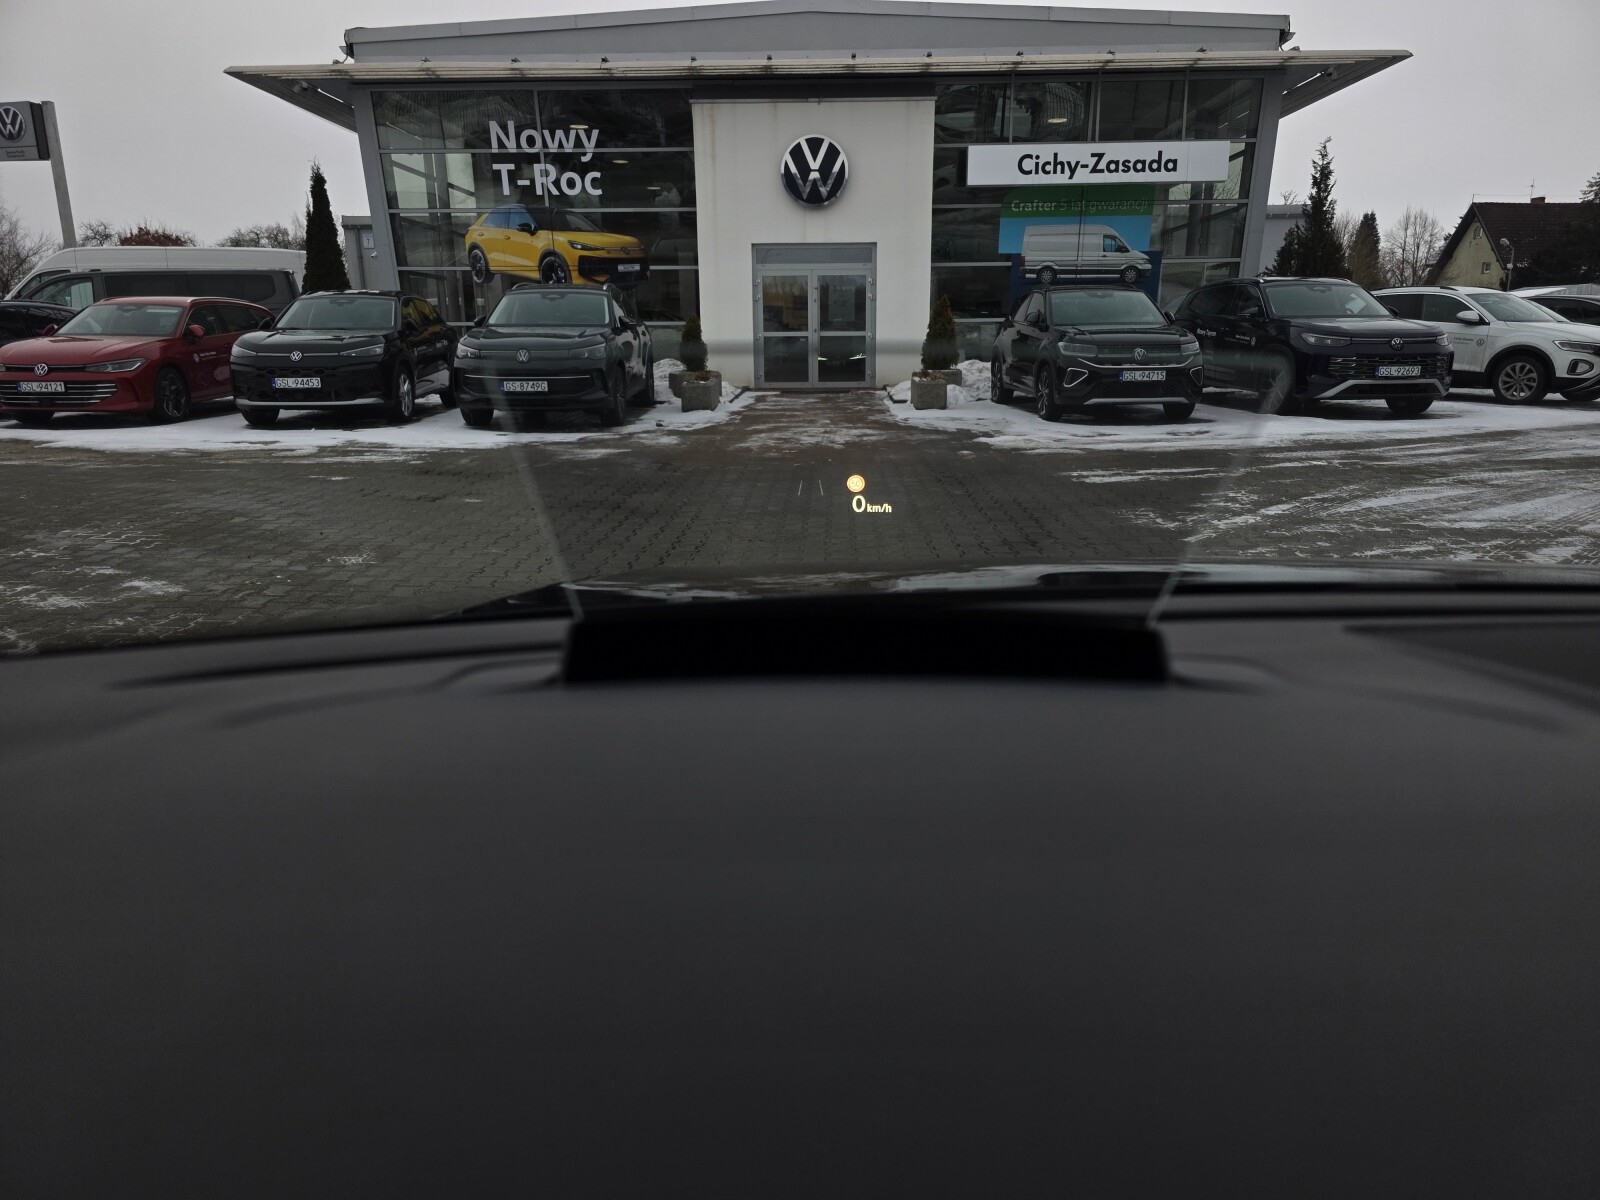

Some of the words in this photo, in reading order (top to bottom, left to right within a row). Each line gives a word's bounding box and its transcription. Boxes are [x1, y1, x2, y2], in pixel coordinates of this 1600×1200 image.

[488, 120, 599, 162] Nowy
[782, 134, 848, 206] VW
[1017, 150, 1178, 180] Cichy-Zasada
[492, 163, 603, 196] T-Roc
[1011, 200, 1057, 212] Crafter
[1059, 199, 1067, 211] 5
[1071, 199, 1086, 211] lat
[1089, 198, 1148, 213] gwarancji
[1123, 371, 1138, 381] GSL
[1141, 371, 1165, 380] 94715
[1379, 366, 1394, 376] GSL
[1396, 366, 1420, 375] 92693
[22, 382, 37, 391] GSL
[38, 382, 64, 391] 94121
[276, 378, 292, 388] GSL
[294, 378, 320, 387] 94453
[505, 381, 517, 391] GS
[519, 381, 547, 391] 8749G
[852, 495, 866, 513] 0
[866, 503, 892, 513] km/h
